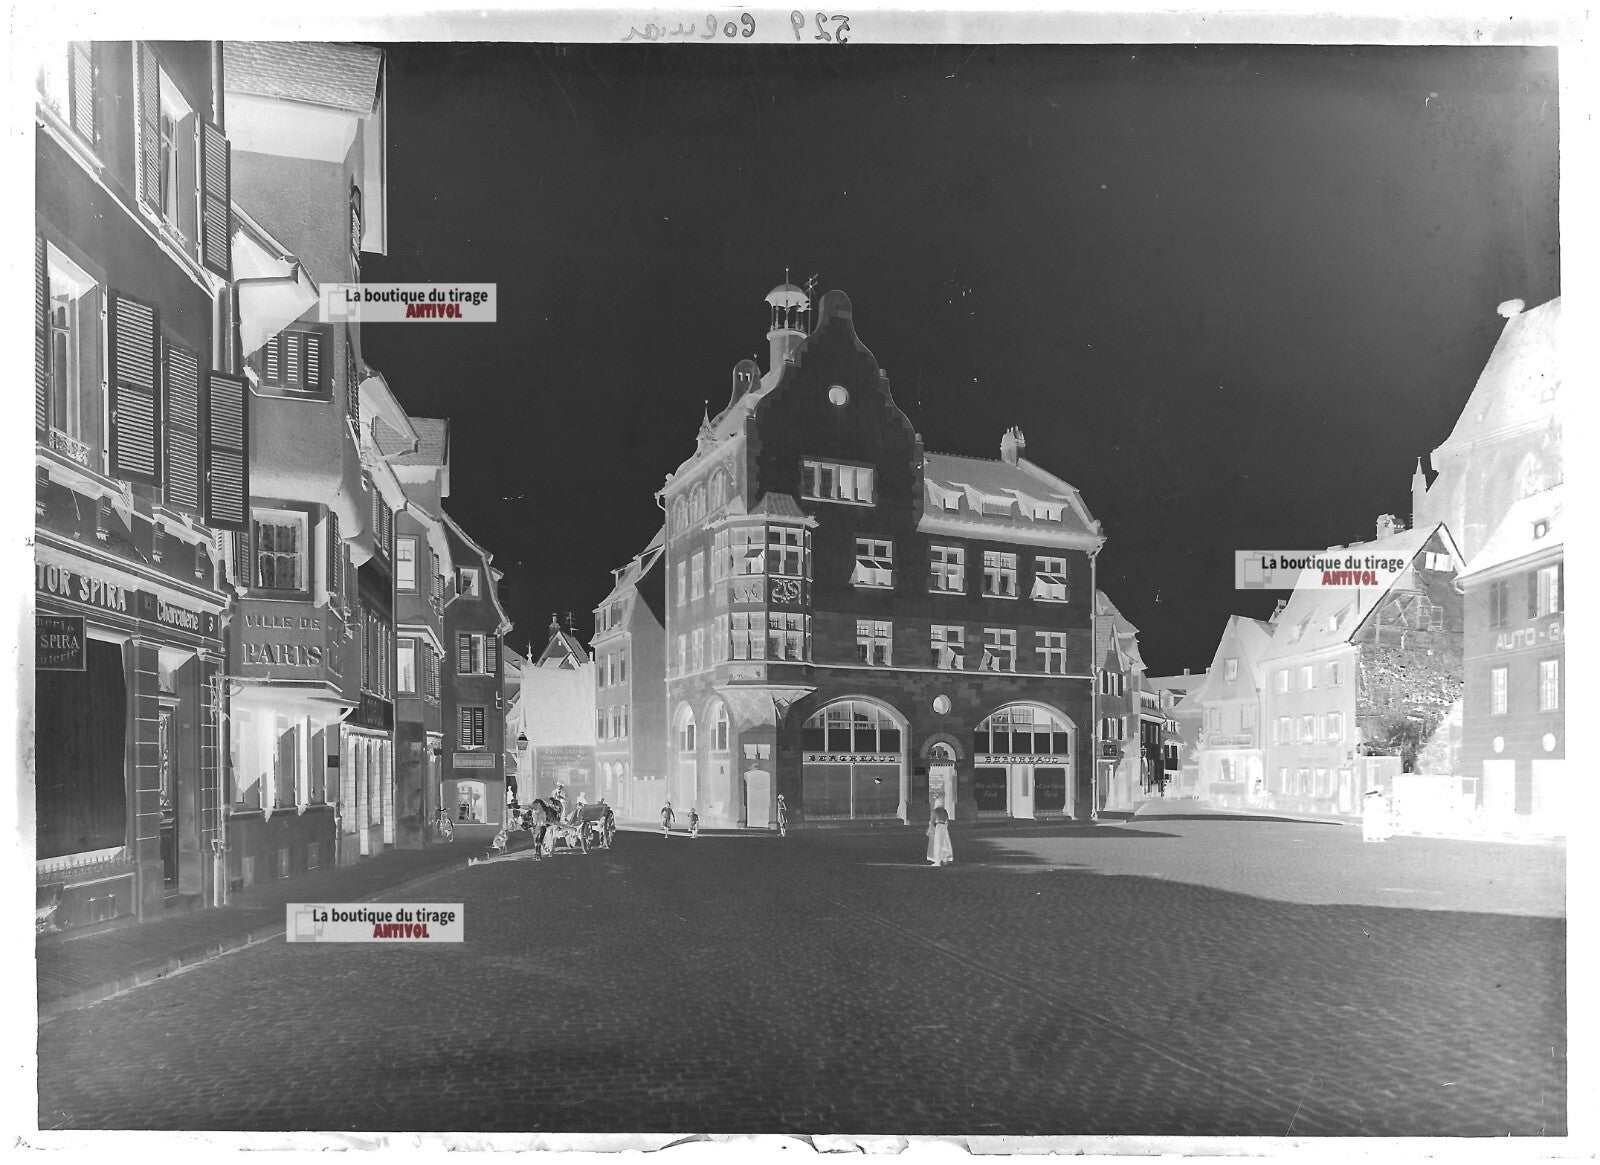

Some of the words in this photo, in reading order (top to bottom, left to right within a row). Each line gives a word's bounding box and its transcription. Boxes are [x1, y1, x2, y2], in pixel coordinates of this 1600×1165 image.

[79, 574, 127, 612] SPIRA
[157, 599, 199, 631] Charcuterie
[208, 616, 214, 632] 3
[245, 615, 293, 629] VILLE
[299, 617, 321, 631] DE
[41, 634, 80, 649] SPIRA
[242, 643, 323, 667] PARIS
